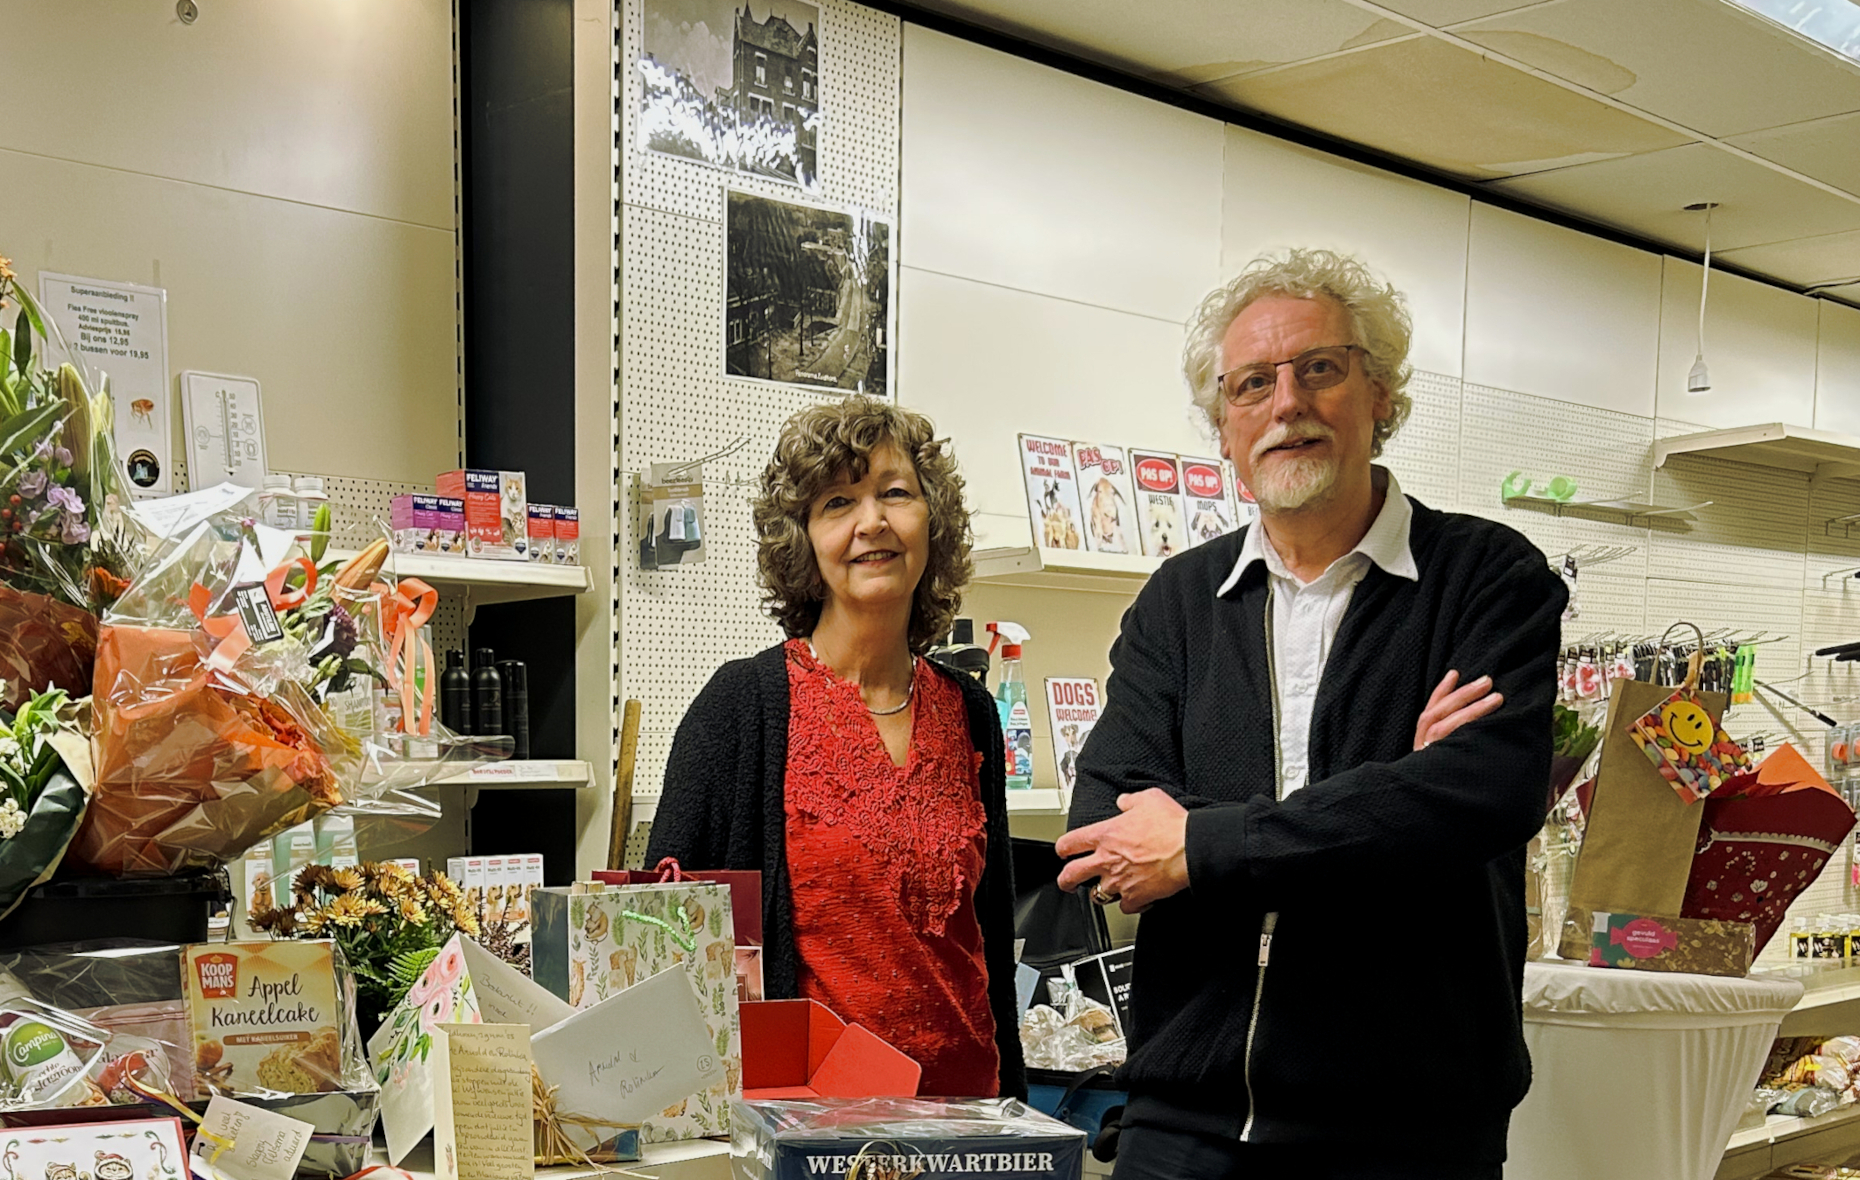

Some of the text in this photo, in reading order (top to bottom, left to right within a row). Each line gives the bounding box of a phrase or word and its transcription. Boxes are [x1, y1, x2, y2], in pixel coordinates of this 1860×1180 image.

[71, 286, 128, 302] Superaanbieding
[83, 305, 97, 314] Free
[99, 308, 139, 321] vlooienspray
[79, 323, 112, 335] Adviesprijs
[81, 332, 129, 346] Bij ons 12,95
[80, 343, 108, 354] bussen
[110, 348, 127, 356] voor
[129, 350, 149, 359] 19,95
[1026, 439, 1068, 457] WELCOME
[1077, 447, 1101, 470] PAS
[466, 473, 499, 483] FELIWAY
[1140, 467, 1174, 483] PAS OP!
[1188, 473, 1204, 487] PAS
[413, 496, 438, 505] FELIWAY
[439, 498, 464, 507] FELIWAY
[1148, 494, 1175, 508] WESTIE
[1197, 500, 1218, 512] MOPS
[529, 506, 552, 514] FELIWAY
[555, 508, 578, 516] FELIWAY
[1052, 682, 1095, 706] DOGS
[1055, 708, 1098, 722] WELCOME!
[201, 963, 233, 977] KOOP
[202, 976, 235, 989] MANS
[248, 973, 303, 1005] Appel
[212, 1002, 320, 1028] Kaneelcake
[251, 1034, 298, 1043] KANEELSUIKER
[13, 1031, 58, 1062] Campina
[458, 1045, 488, 1056] Arnold
[38, 1062, 60, 1077] echte
[806, 1152, 1054, 1174] WESTERKWARTBIER
